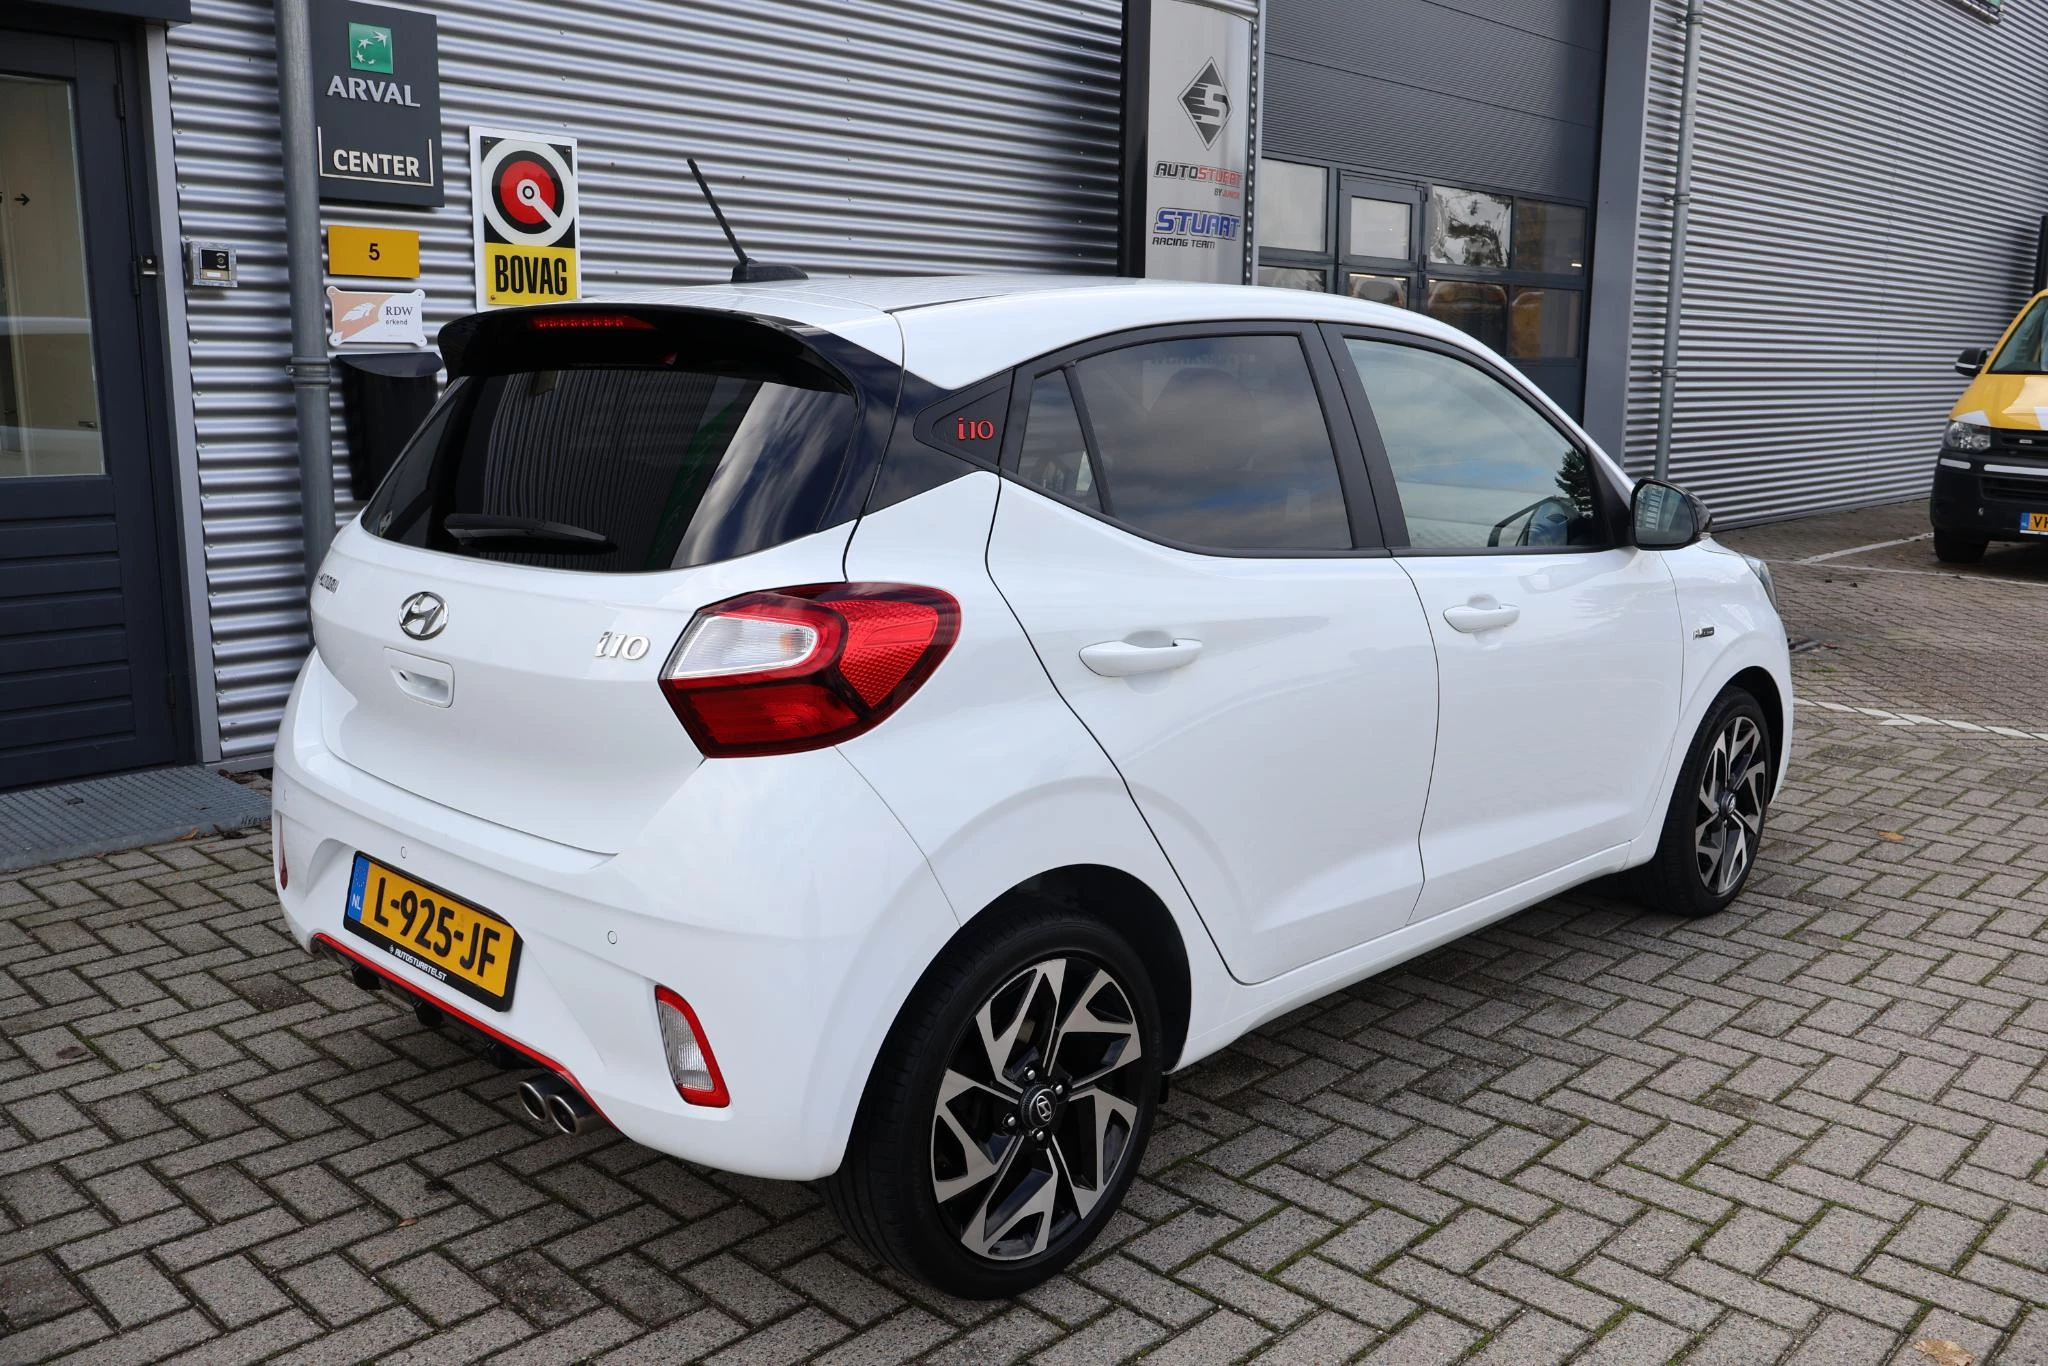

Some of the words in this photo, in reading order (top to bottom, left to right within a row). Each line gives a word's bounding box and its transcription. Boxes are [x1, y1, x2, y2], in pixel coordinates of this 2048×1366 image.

[327, 75, 421, 107] ARVAL
[333, 149, 420, 178] CENTER
[1154, 161, 1242, 187] AUTOSTUART
[1154, 208, 1241, 239] STUART
[368, 242, 381, 261] 5
[1152, 237, 1189, 247] RACING
[1191, 239, 1216, 249] TEAM
[494, 254, 568, 296] BOVAG
[385, 306, 414, 316] RDW
[385, 318, 408, 326] erkend
[957, 416, 994, 440] i10
[594, 631, 651, 661] i10
[351, 893, 361, 910] NL
[374, 876, 501, 978] L-925-JF
